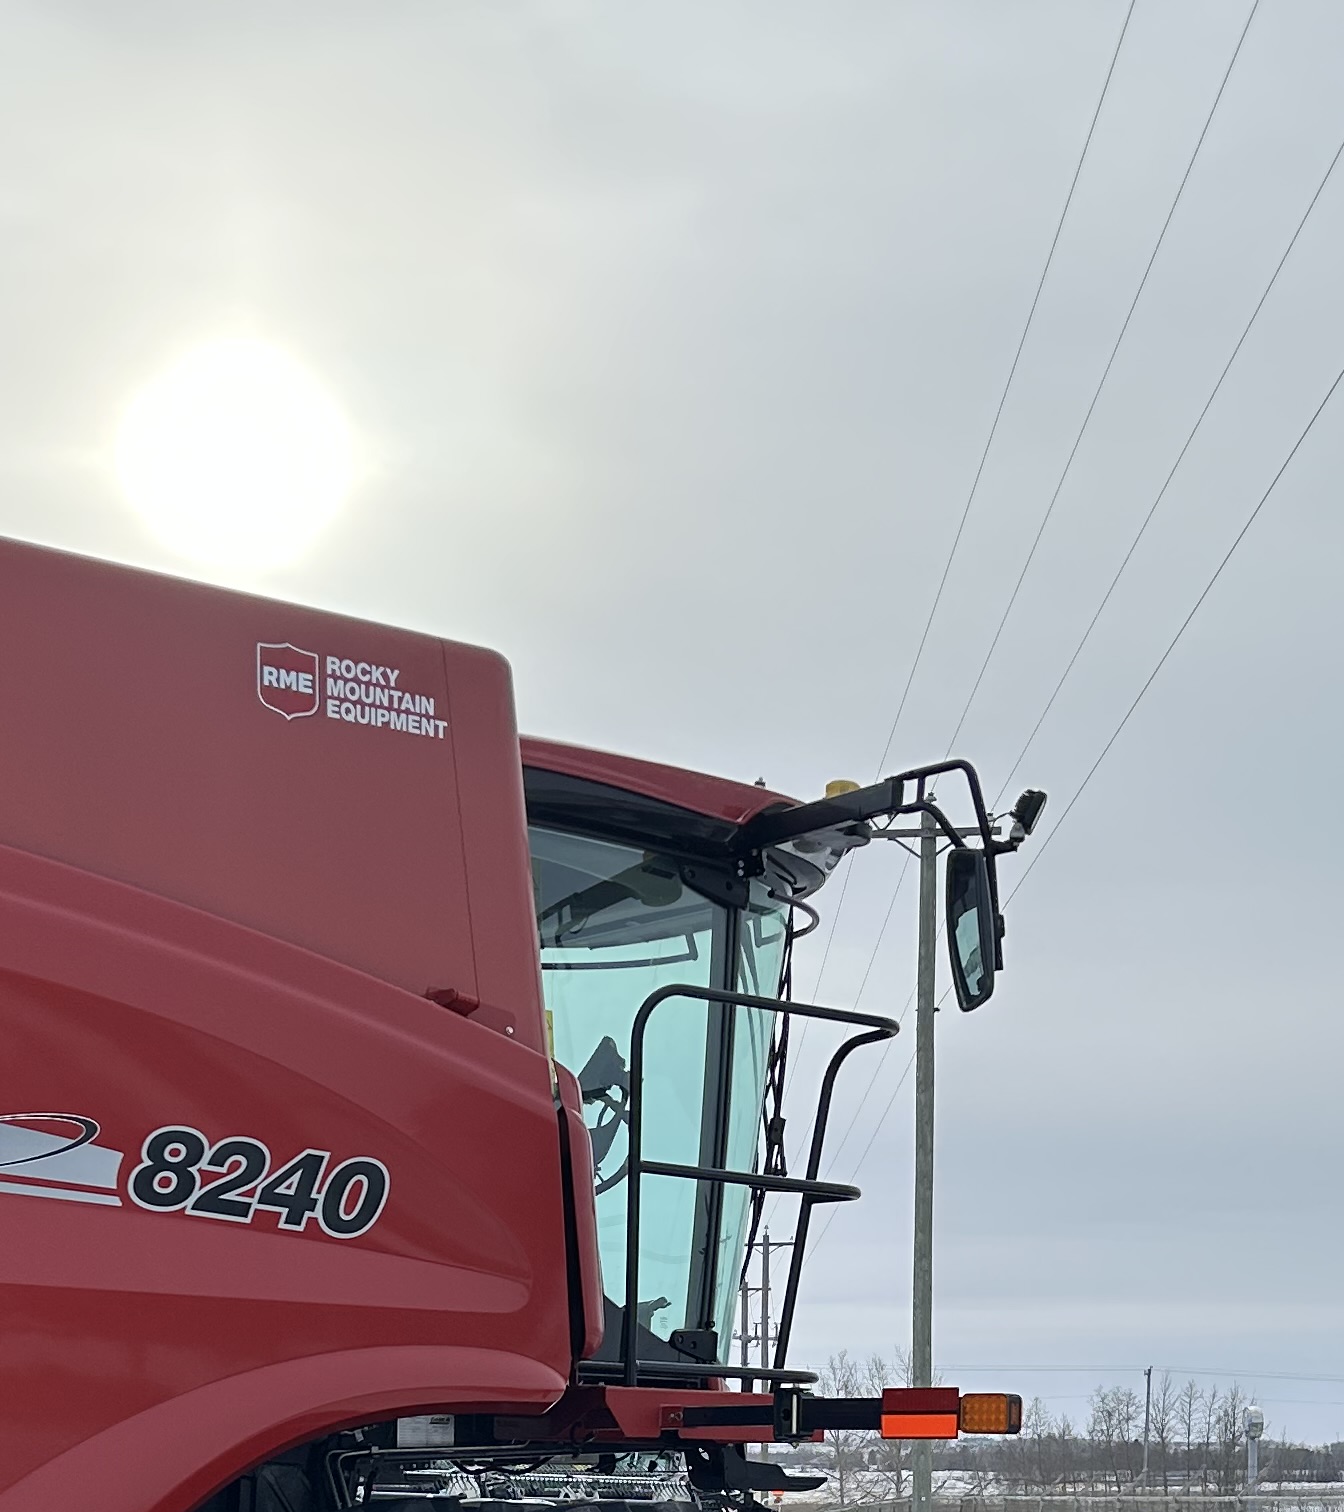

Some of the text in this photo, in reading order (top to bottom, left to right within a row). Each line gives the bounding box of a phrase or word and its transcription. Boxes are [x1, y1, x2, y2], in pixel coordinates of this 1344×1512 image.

[262, 665, 314, 695] RME
[326, 656, 400, 687] ROCKY
[326, 677, 435, 716] MOUNTAIN
[326, 699, 448, 739] EQUIPMENT
[127, 1125, 390, 1239] 8240
